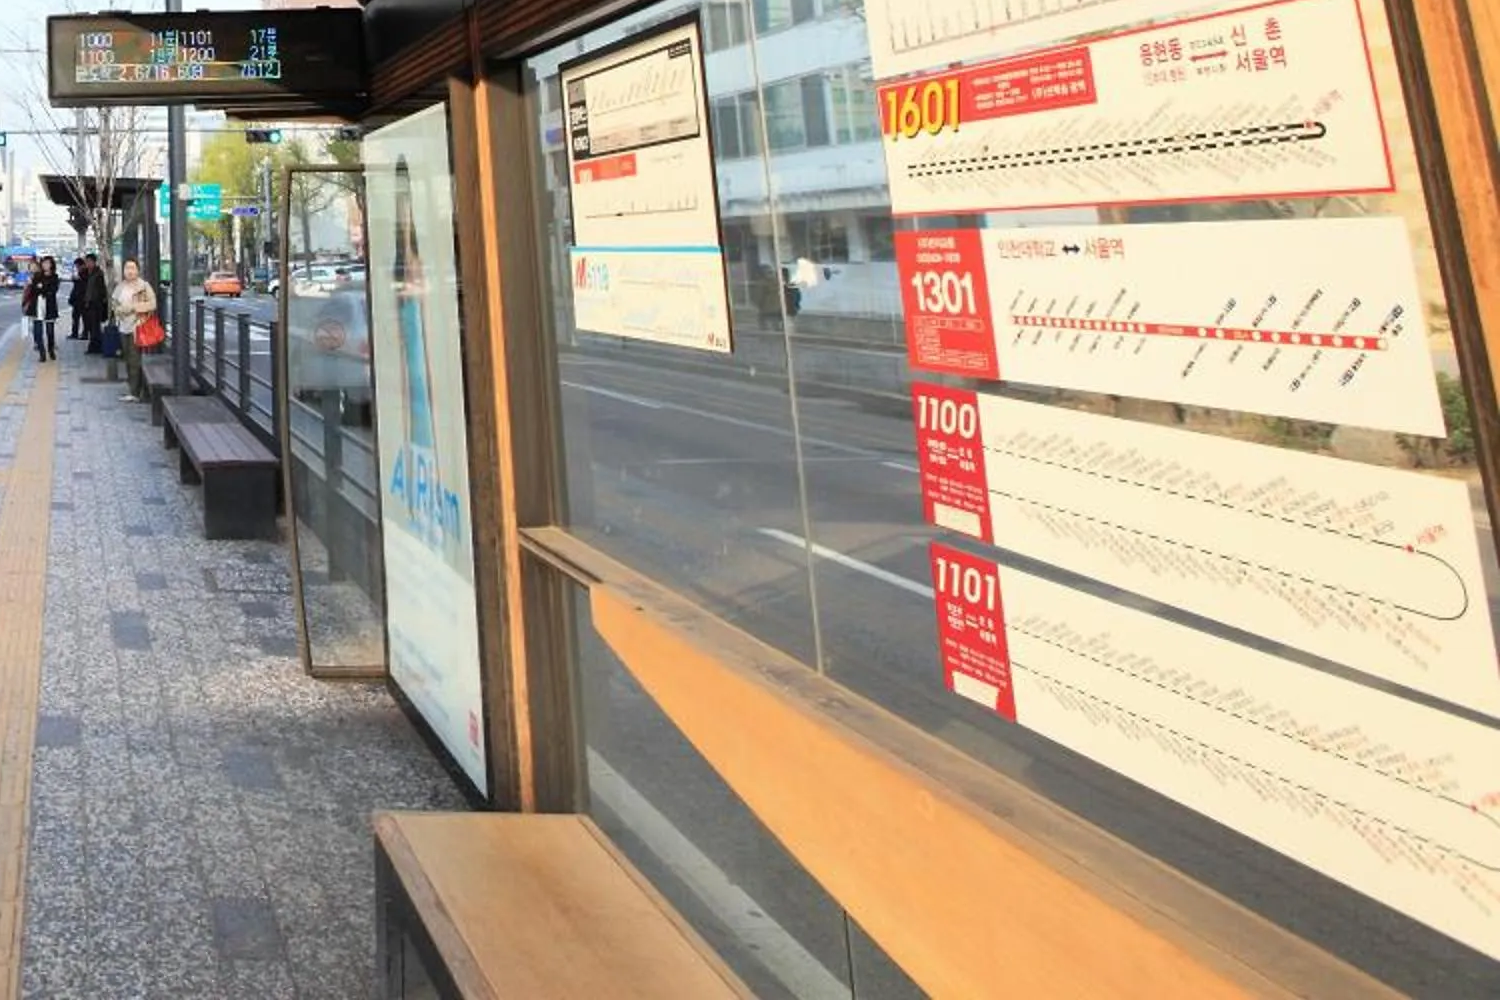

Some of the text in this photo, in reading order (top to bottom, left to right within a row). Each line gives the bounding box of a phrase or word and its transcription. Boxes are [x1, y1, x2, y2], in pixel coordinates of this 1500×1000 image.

[181, 30, 213, 45] 1101
[181, 47, 215, 62] 1200
[1235, 45, 1288, 73] 서울역
[885, 78, 961, 142] 1601
[1085, 237, 1125, 260] 서울역
[911, 270, 977, 315] 1301
[917, 395, 977, 440] 1100
[935, 557, 997, 612] 1101
